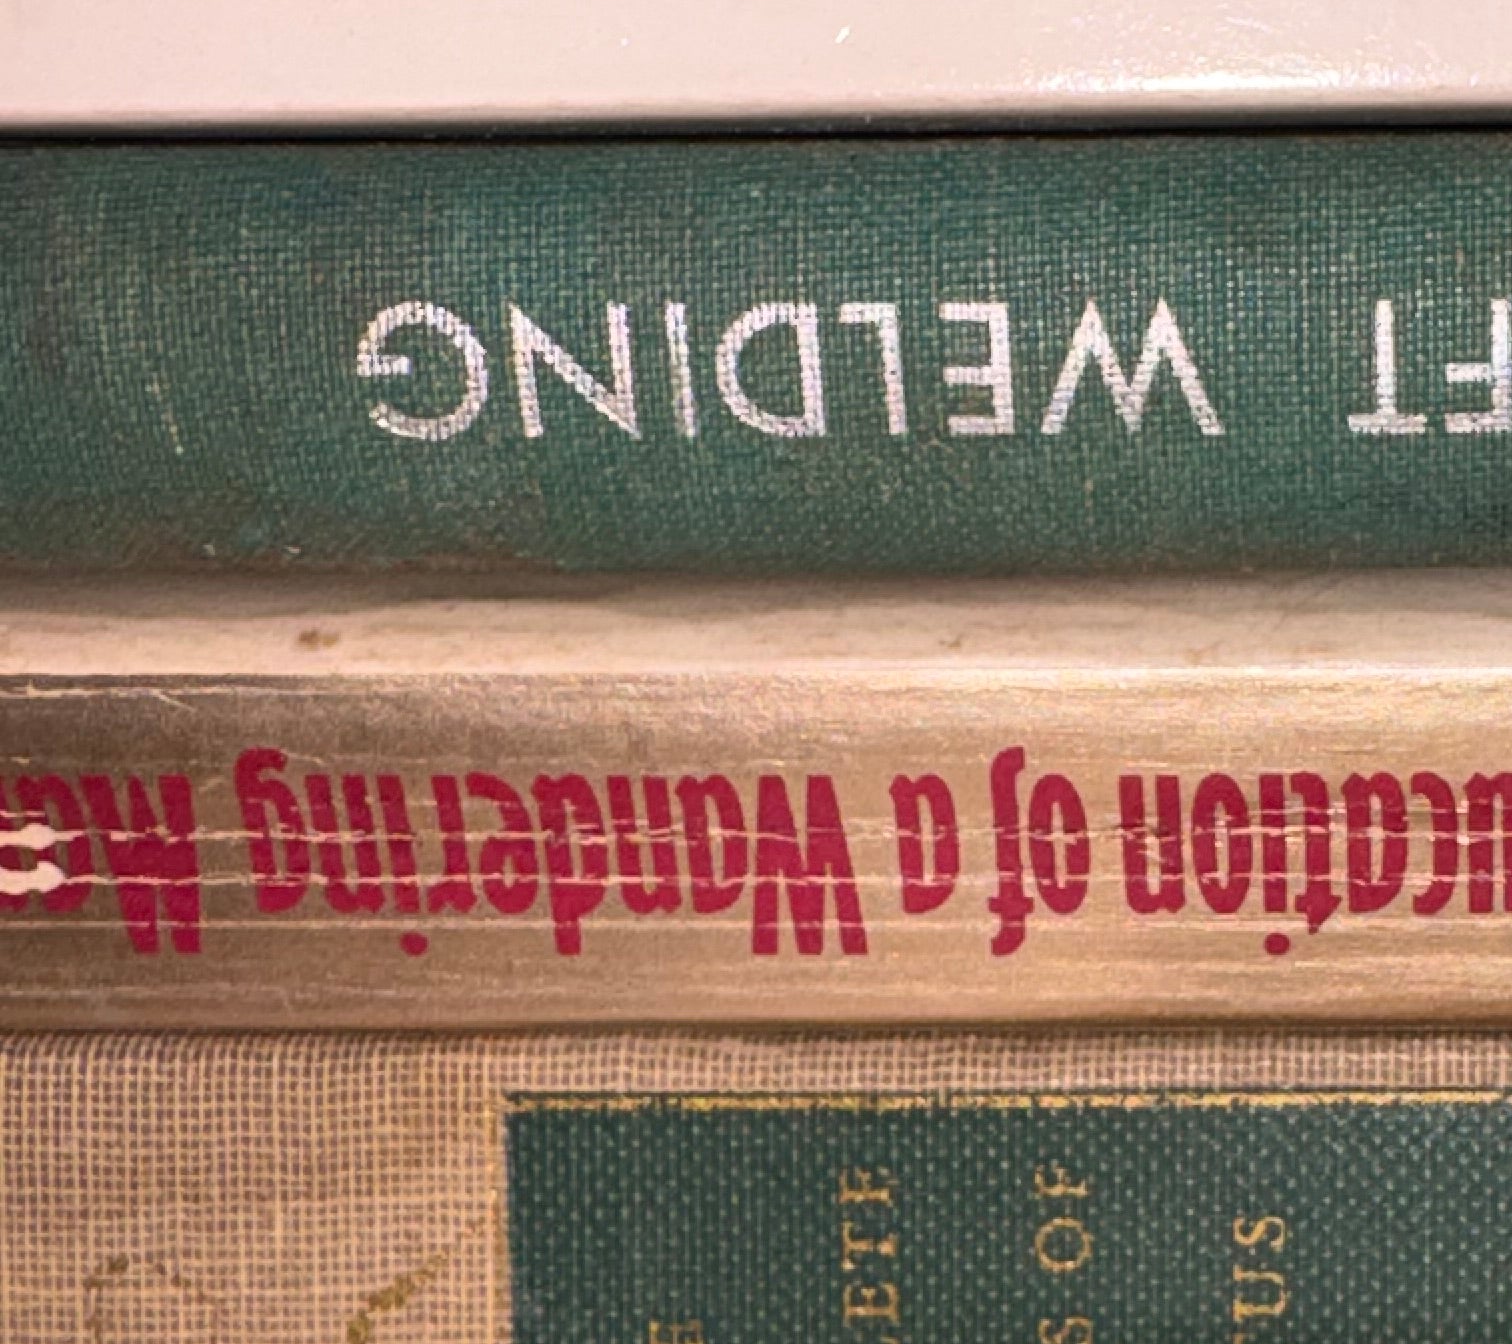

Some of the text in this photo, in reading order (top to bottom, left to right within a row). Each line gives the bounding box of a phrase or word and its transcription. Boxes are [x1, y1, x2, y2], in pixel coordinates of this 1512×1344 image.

[357, 297, 1226, 442] WELDING
[234, 746, 868, 955] Wandering
[892, 776, 958, 913] a
[988, 746, 1090, 955] of
